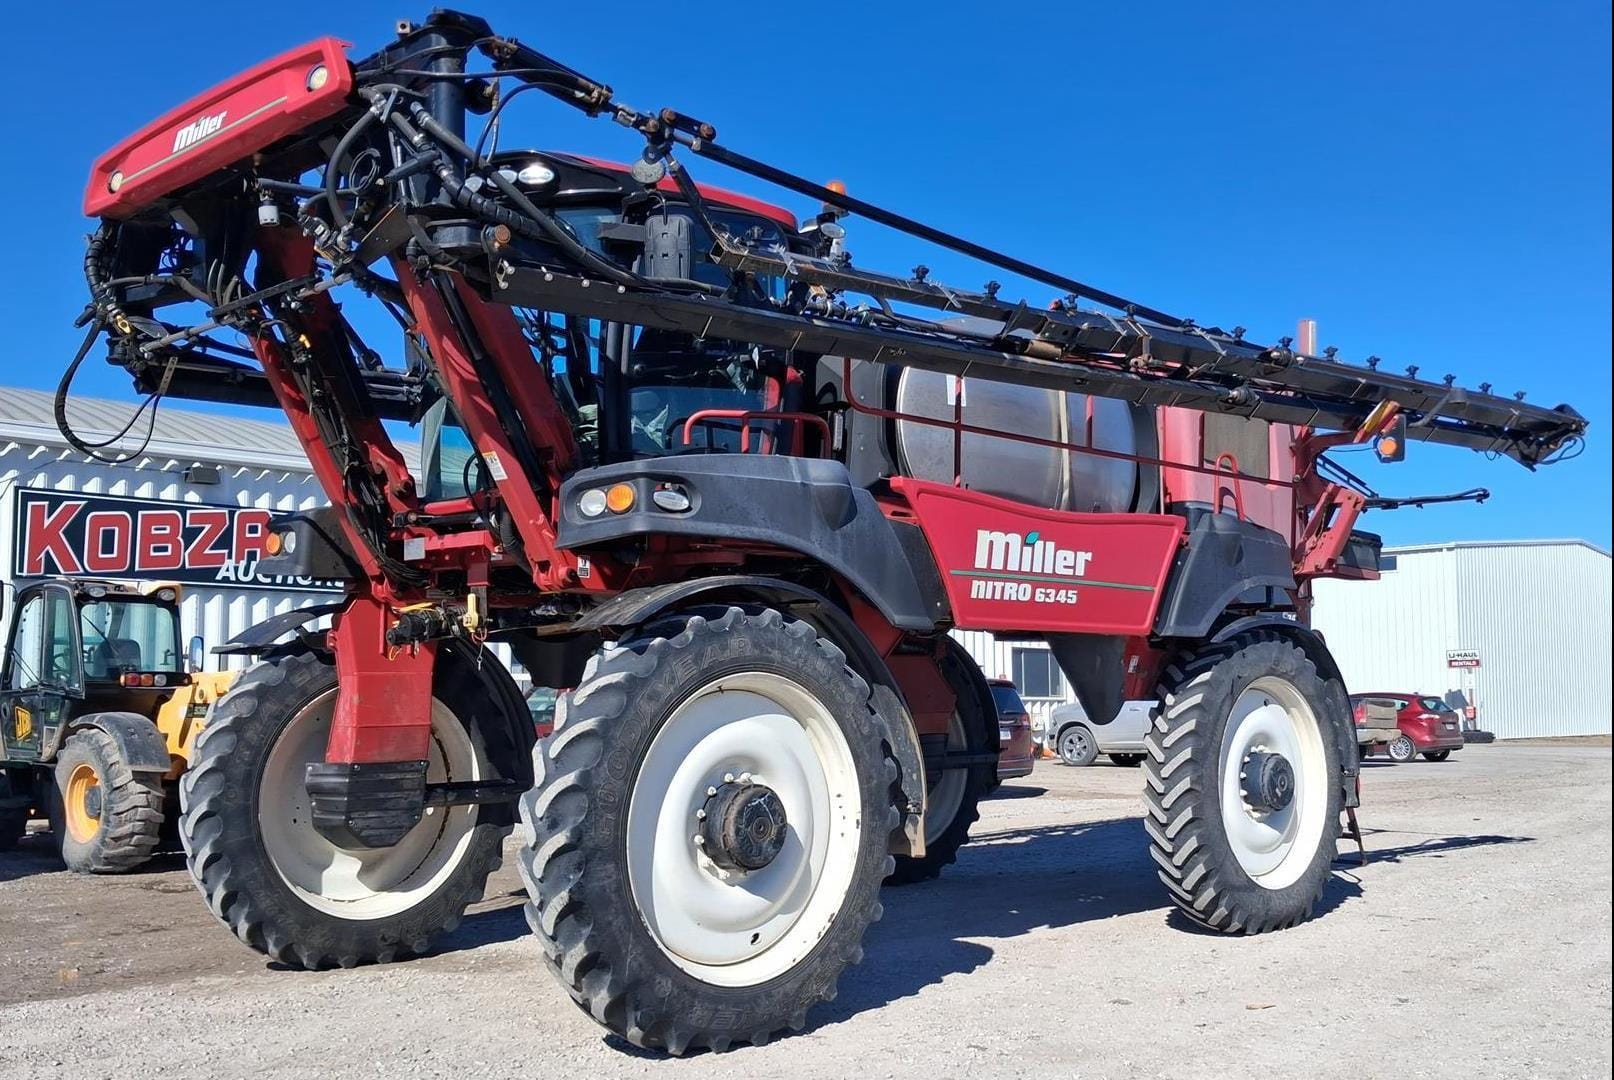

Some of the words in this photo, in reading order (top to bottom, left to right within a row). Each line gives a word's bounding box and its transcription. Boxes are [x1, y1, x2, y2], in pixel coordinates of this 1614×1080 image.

[25, 501, 273, 576] KOBZA
[970, 579, 1032, 602] NITRO
[1034, 587, 1077, 604] 6345
